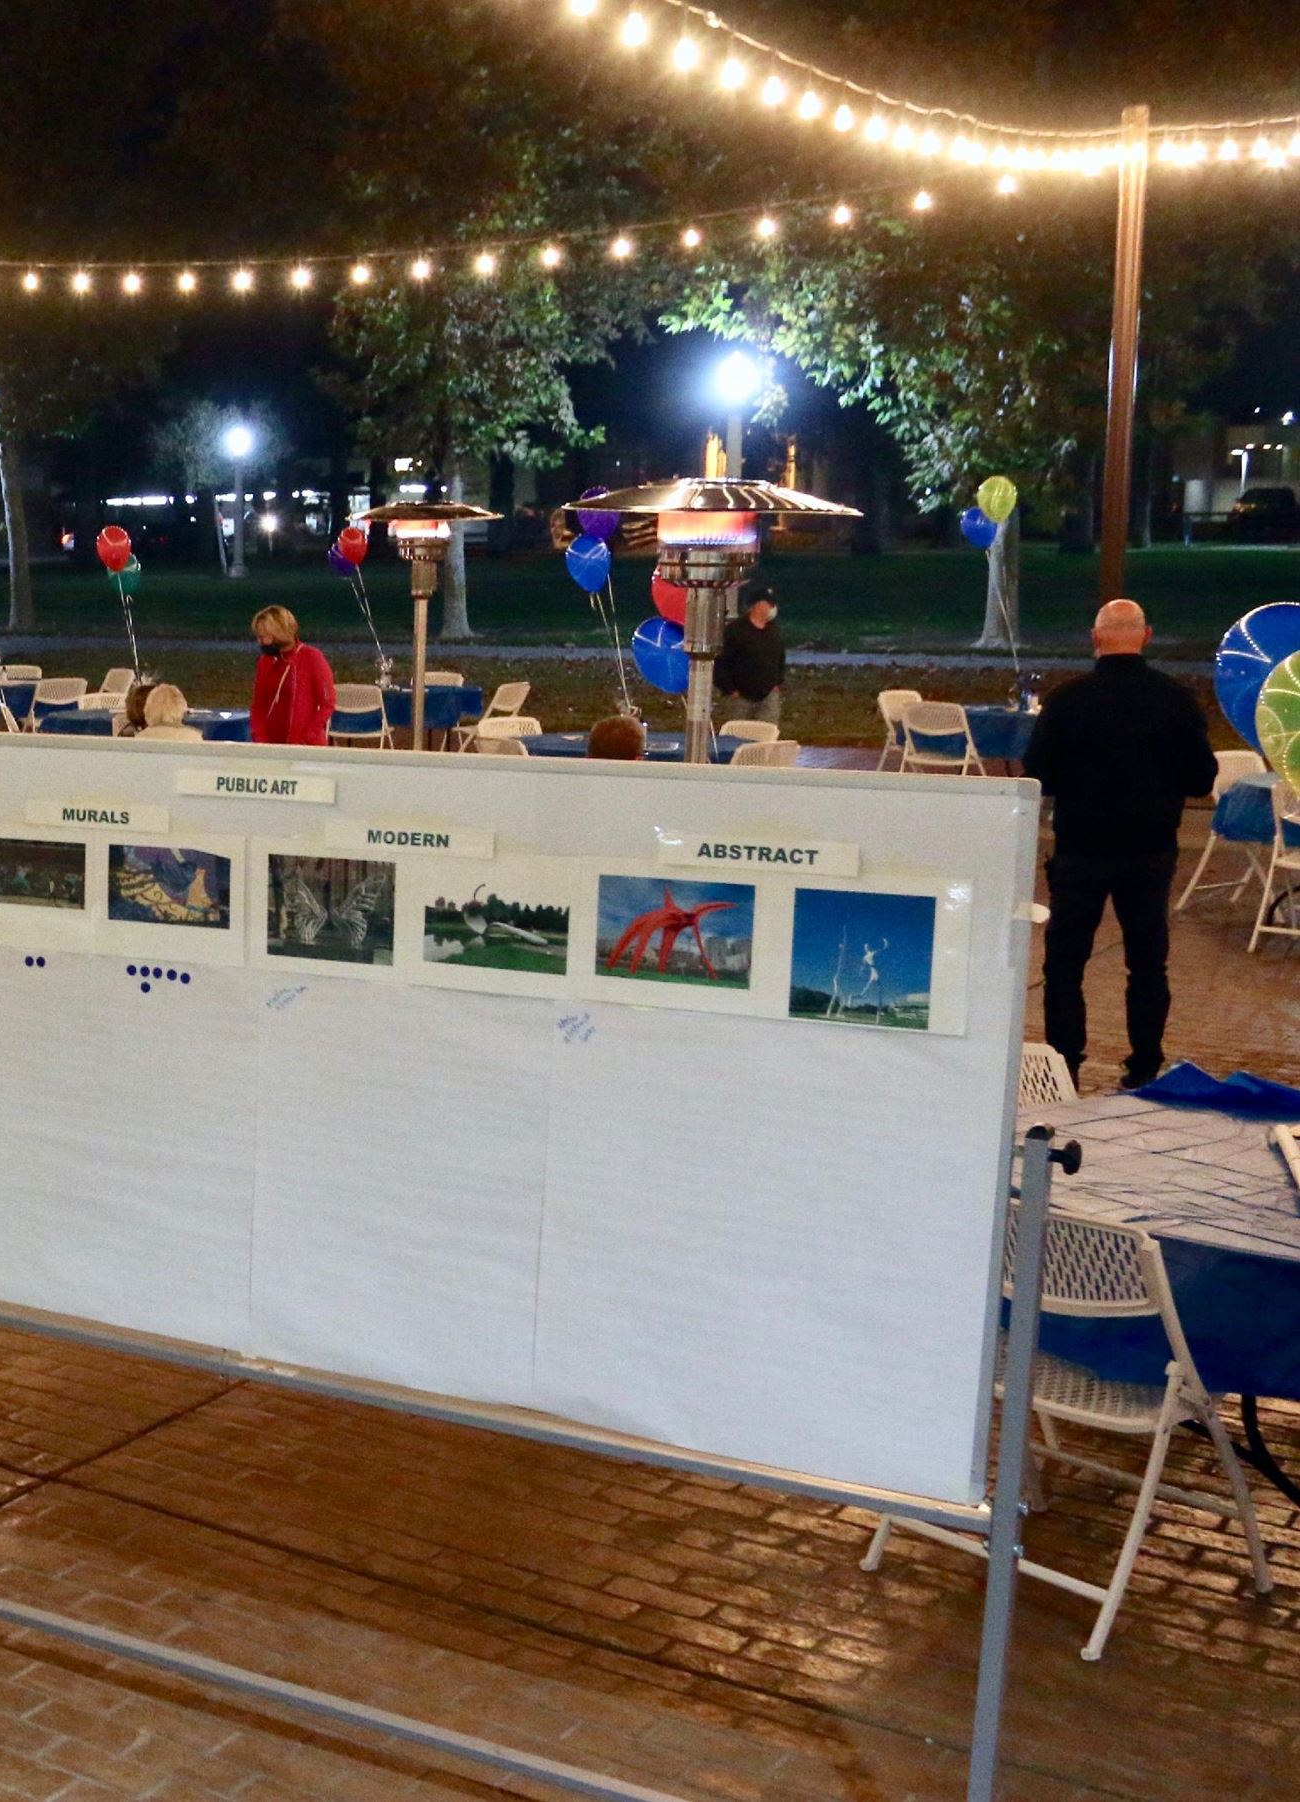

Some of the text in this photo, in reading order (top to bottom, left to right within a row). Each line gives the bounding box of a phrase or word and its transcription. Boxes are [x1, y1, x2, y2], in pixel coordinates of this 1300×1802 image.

[216, 776, 298, 796] PUBLIC ART
[62, 807, 130, 825] MURALS
[367, 829, 450, 848] MODERN
[697, 842, 819, 866] ABSTRACT
